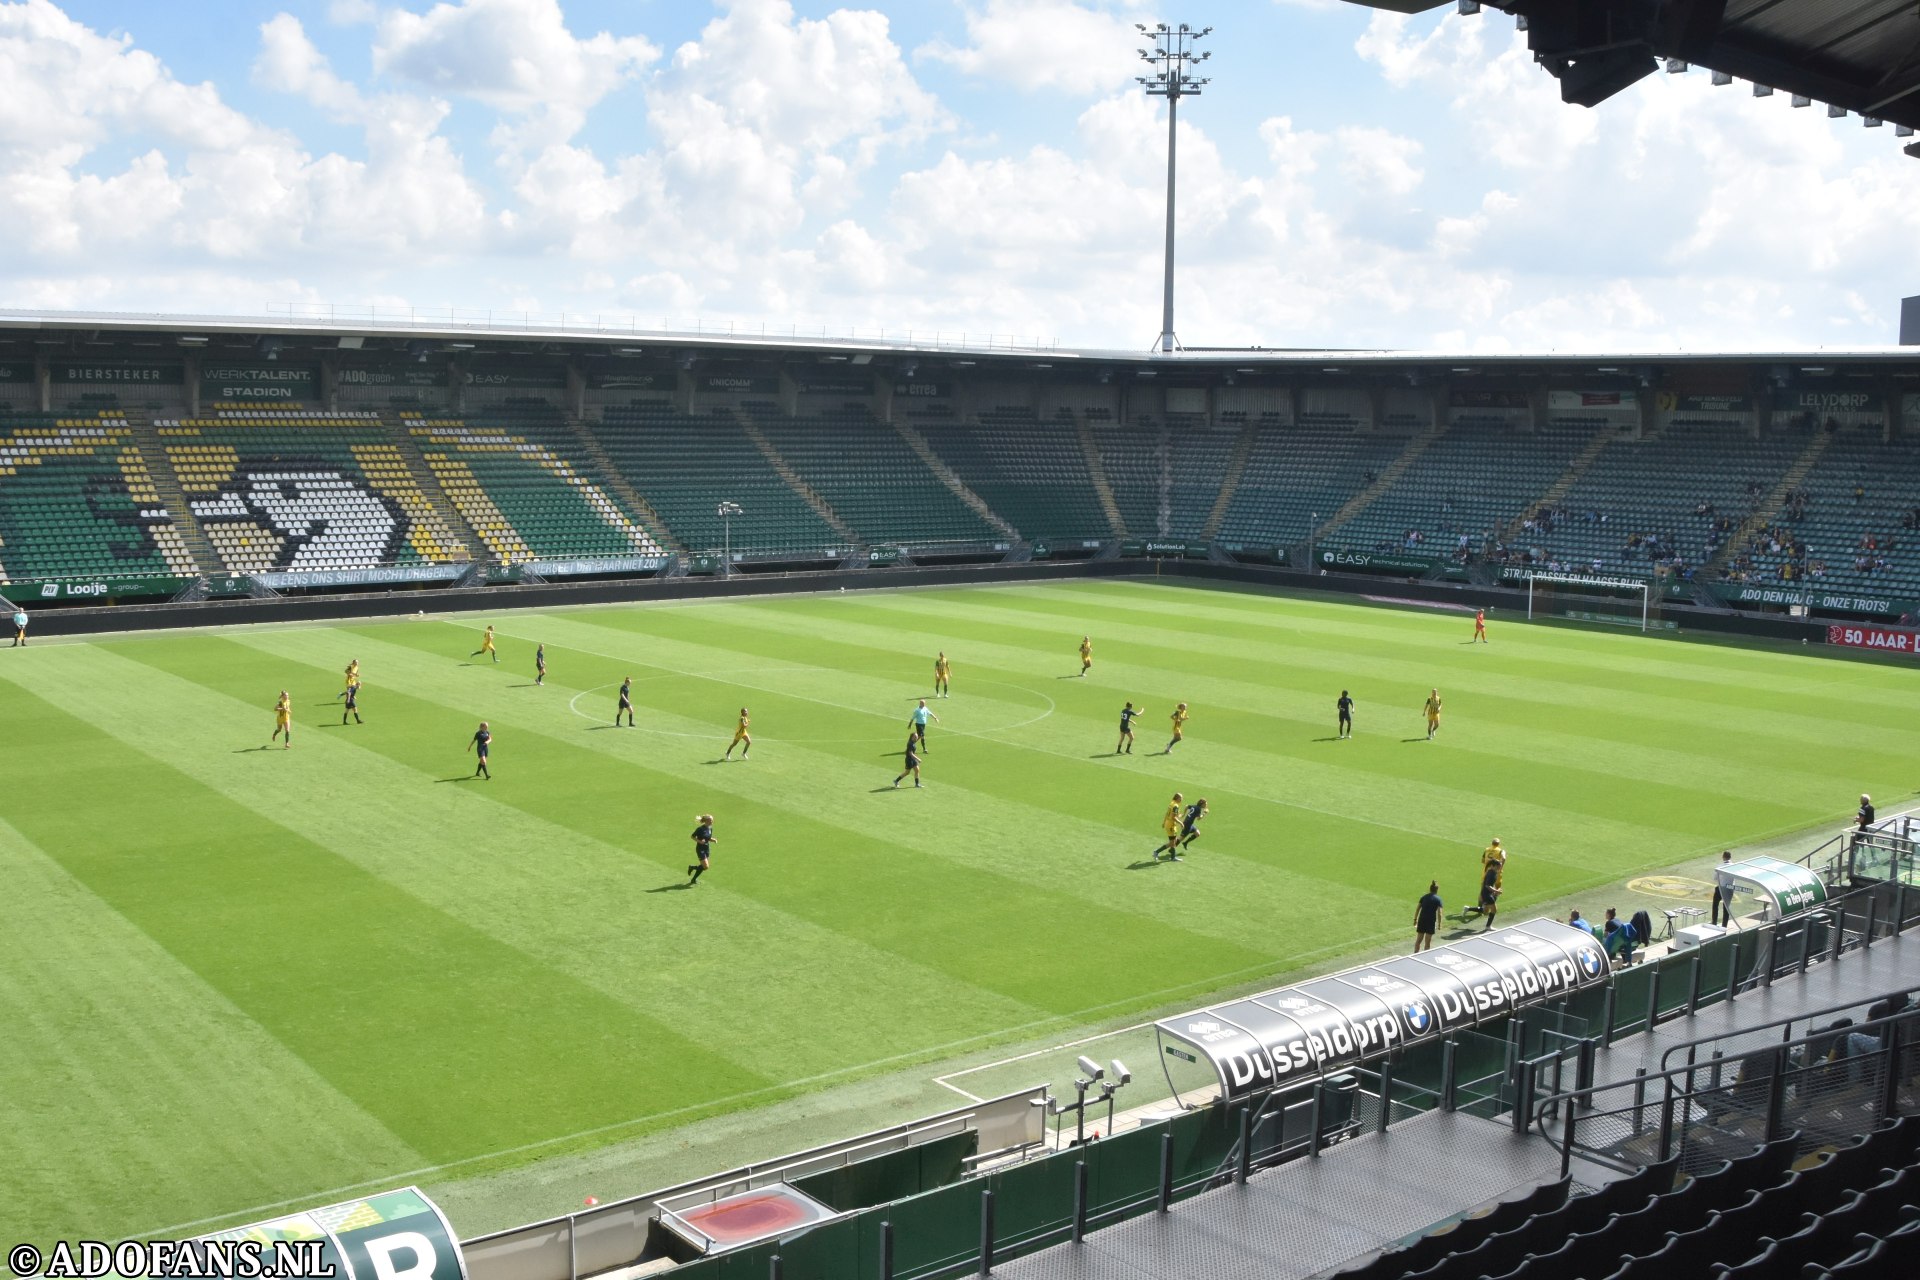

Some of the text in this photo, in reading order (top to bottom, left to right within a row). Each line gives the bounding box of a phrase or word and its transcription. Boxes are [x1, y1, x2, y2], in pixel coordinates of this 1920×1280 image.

[68, 369, 161, 380] BIERSTEKER
[475, 374, 509, 384] EASY
[709, 378, 751, 387] UNICOMM
[223, 387, 292, 397] STADION
[1799, 393, 1869, 407] LELYDORP
[622, 559, 643, 570] NIET
[643, 558, 659, 569] ZO!
[1336, 553, 1371, 566] EASY
[1372, 558, 1430, 569] technical solutions
[281, 573, 308, 586] EENS
[311, 572, 334, 584] ONS
[336, 571, 367, 583] SHIRT
[368, 569, 404, 581] MOCHT
[66, 582, 108, 596] Looije
[1739, 589, 1762, 601] ADO
[1763, 590, 1785, 603] DEN
[1822, 596, 1851, 609] ONZE
[1852, 598, 1890, 613] TROTS!
[1844, 629, 1863, 644] 50
